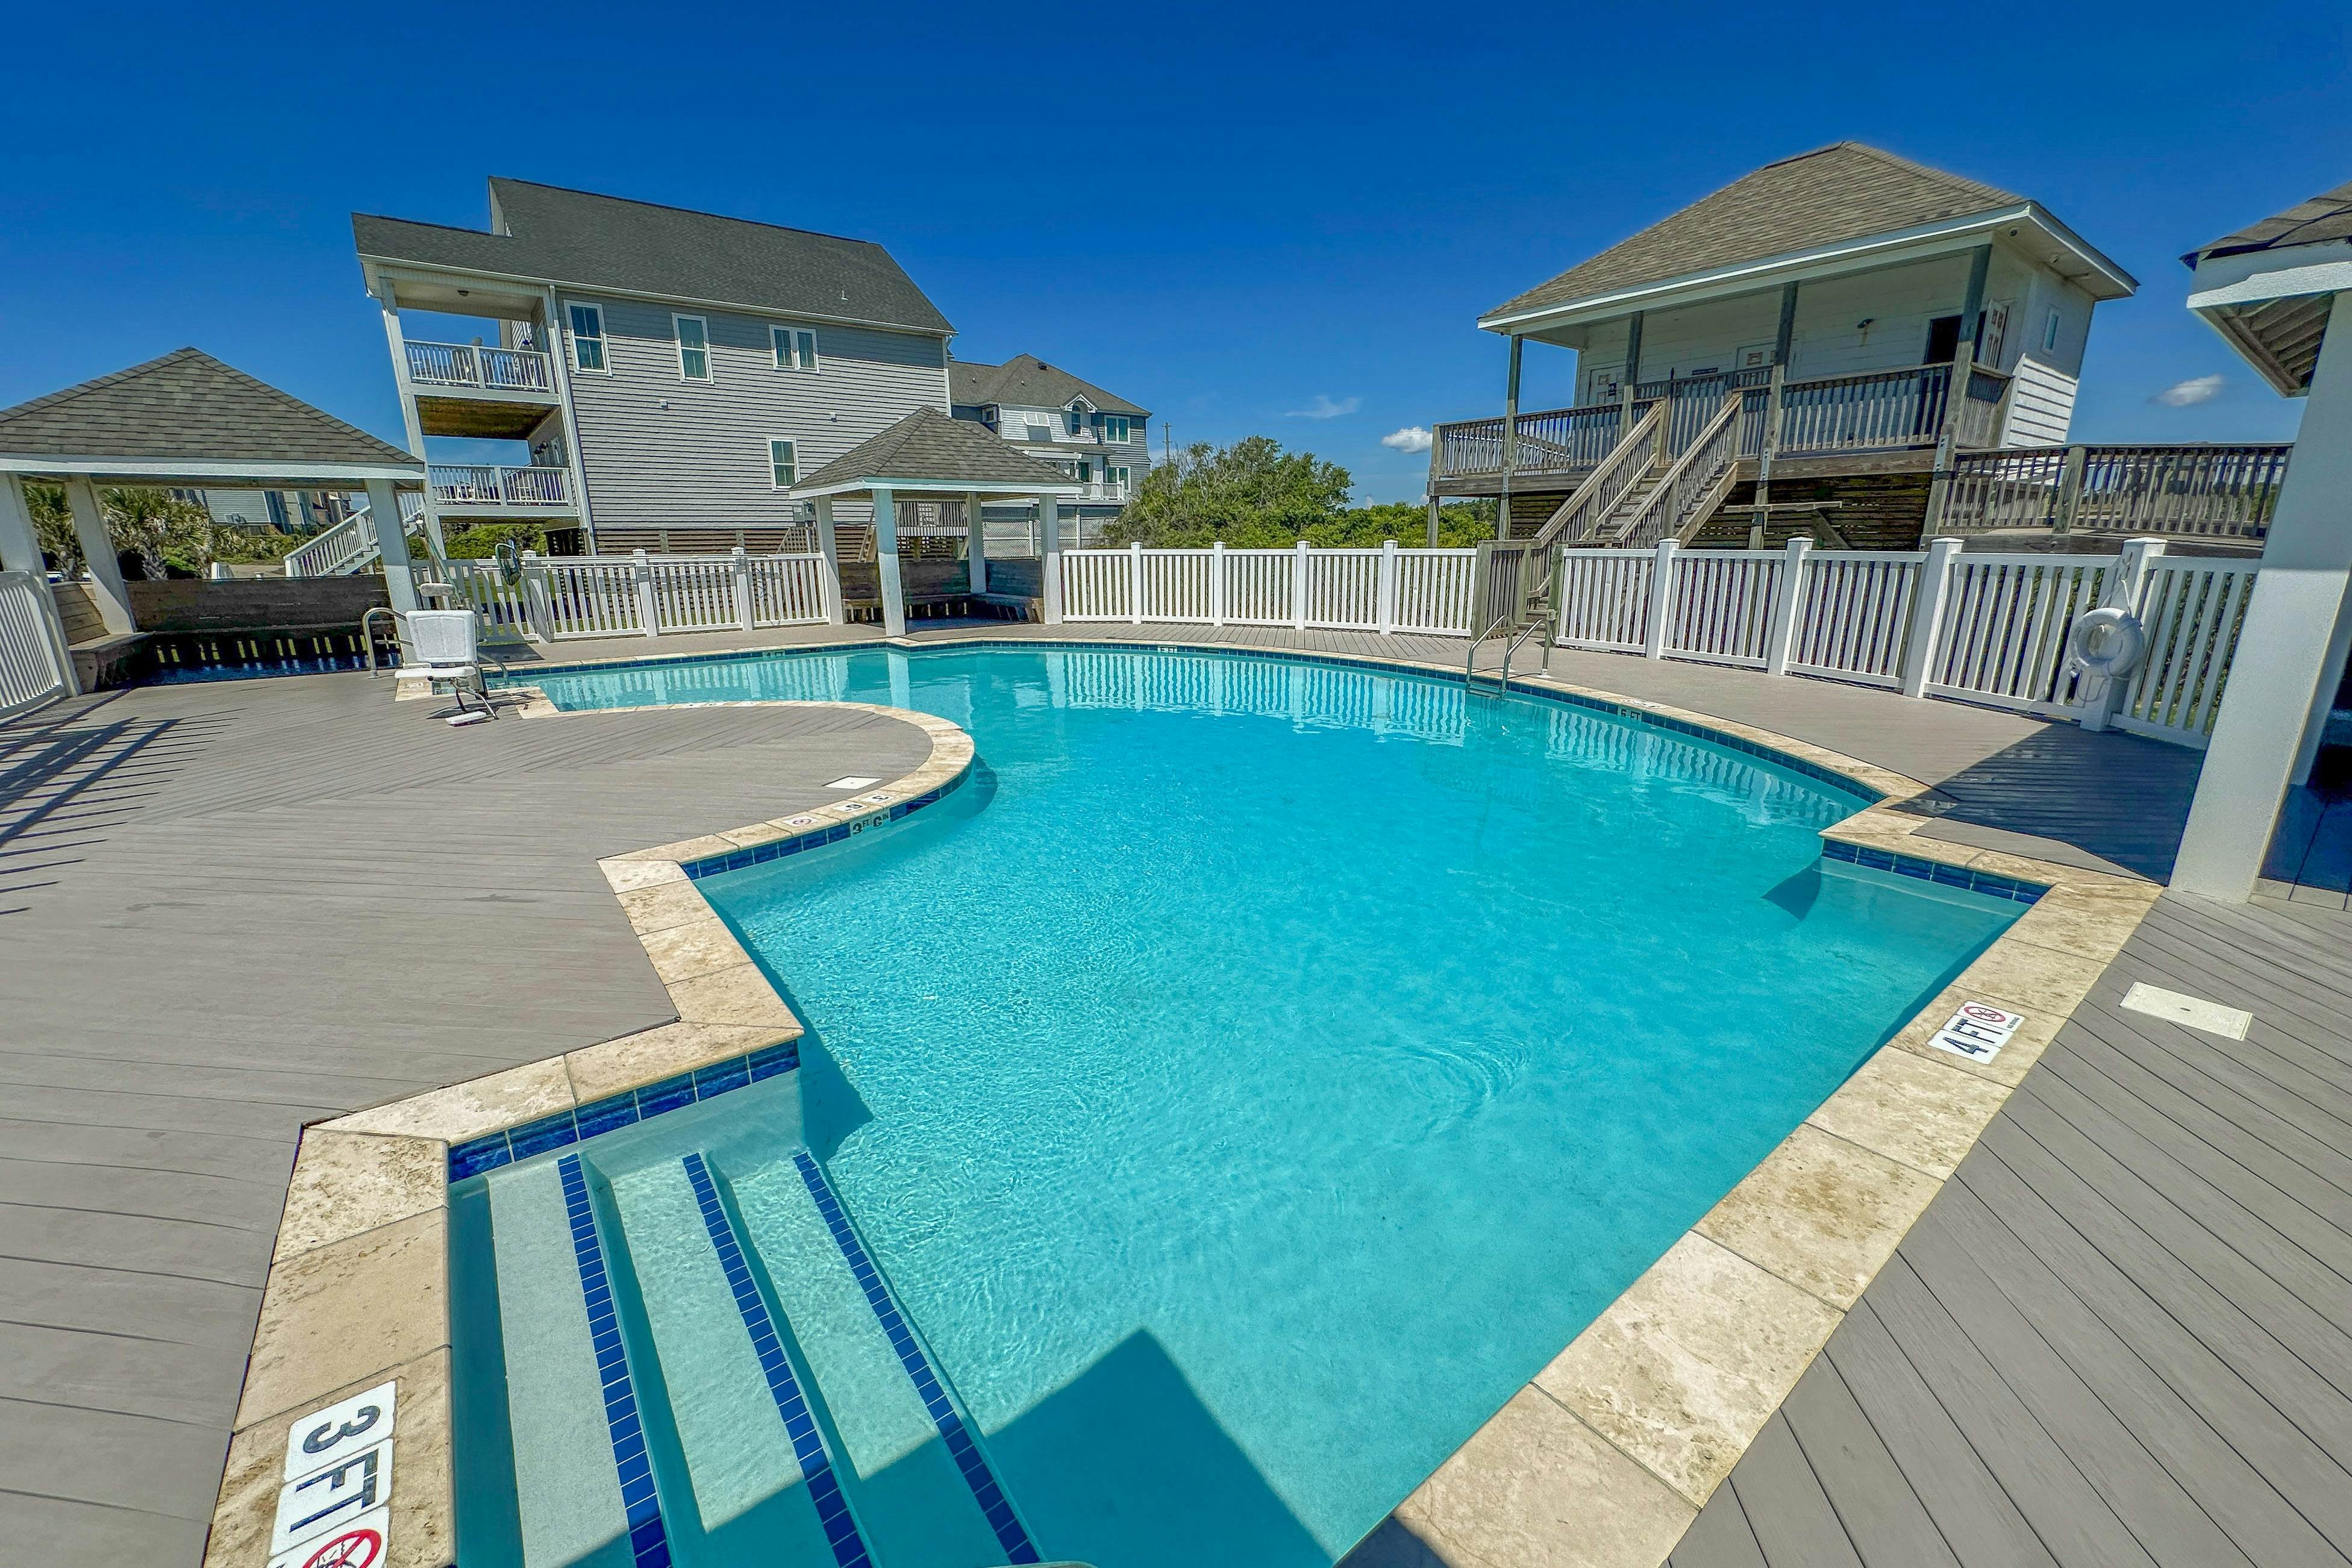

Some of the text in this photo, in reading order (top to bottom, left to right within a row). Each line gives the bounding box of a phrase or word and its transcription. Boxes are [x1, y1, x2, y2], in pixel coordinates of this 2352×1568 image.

[1943, 1018, 2003, 1054] 4 FT
[289, 1405, 381, 1532] 3 FT
